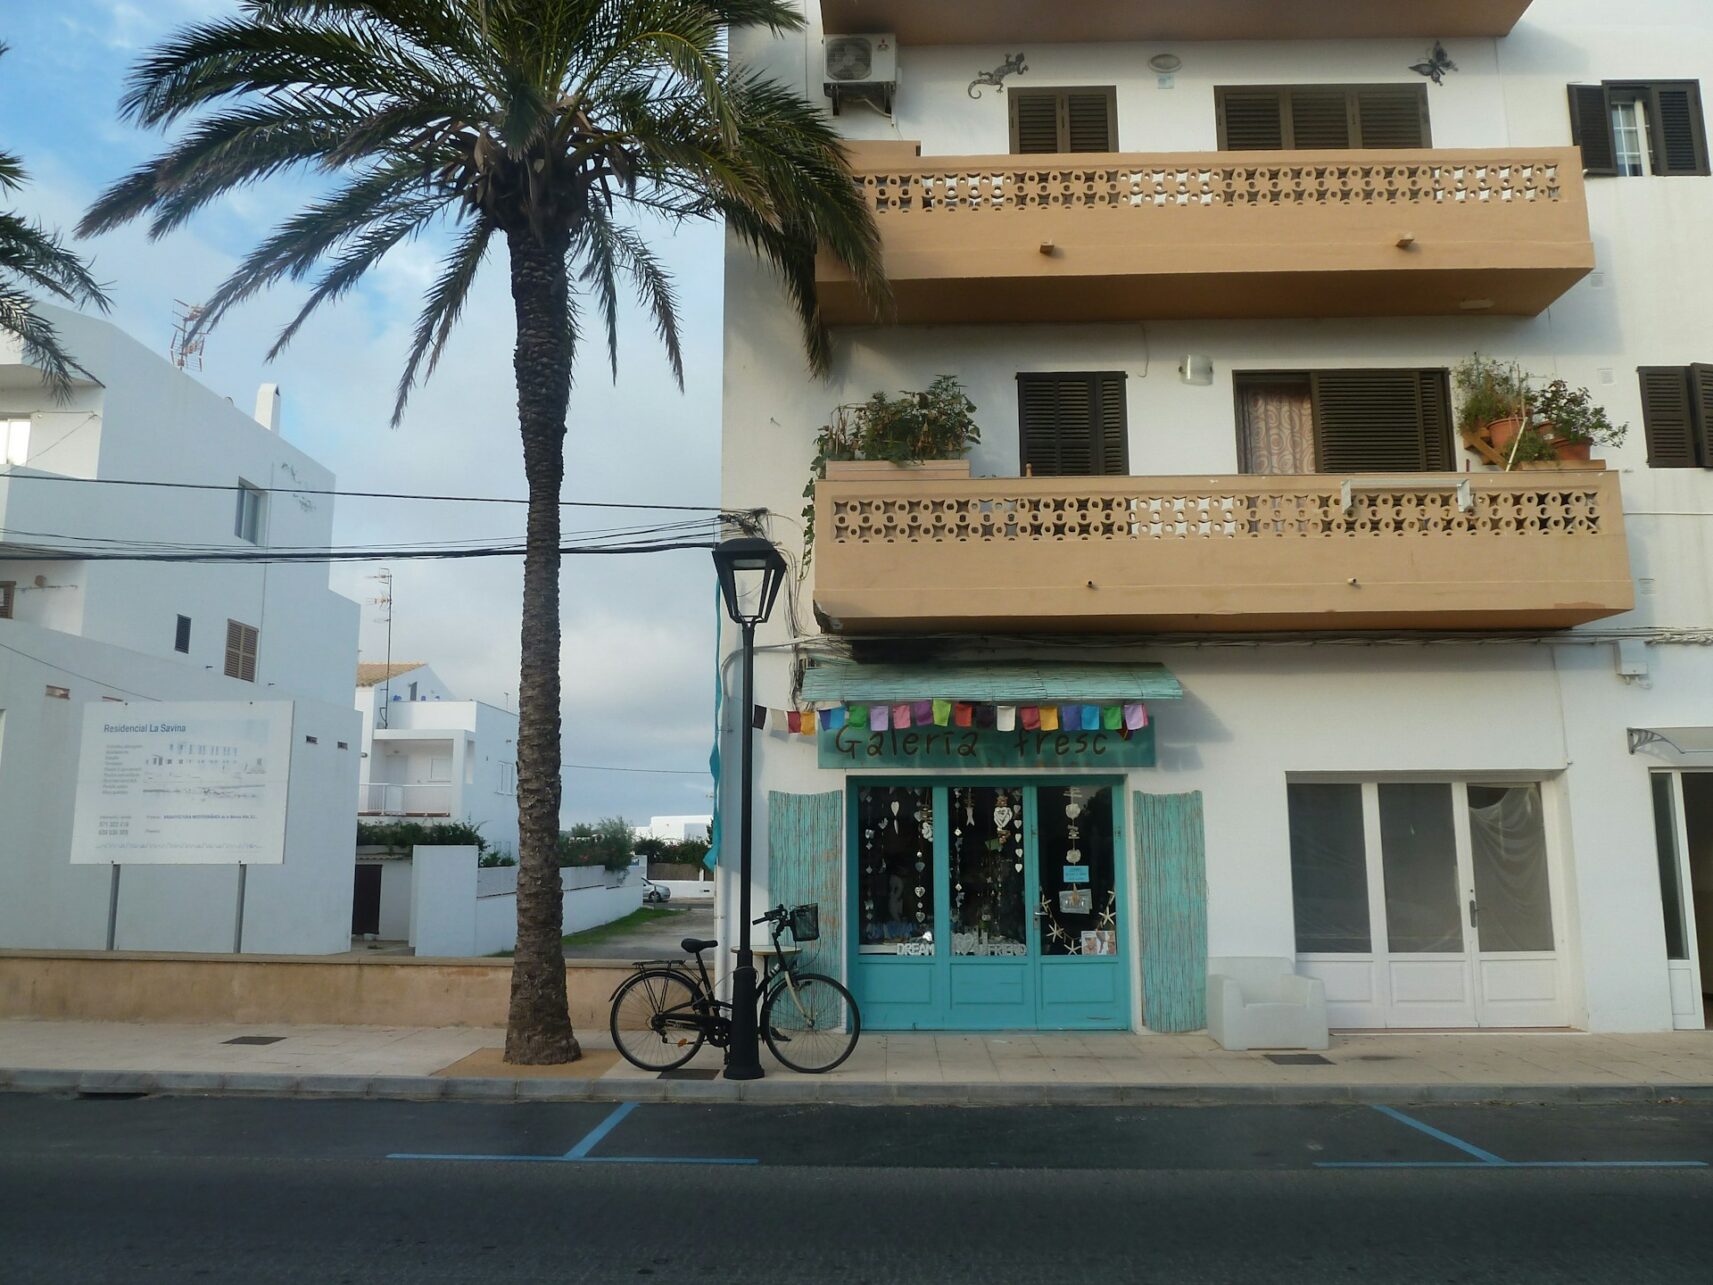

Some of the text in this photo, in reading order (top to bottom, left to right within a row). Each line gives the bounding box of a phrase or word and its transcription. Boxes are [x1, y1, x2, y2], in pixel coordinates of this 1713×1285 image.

[103, 723, 187, 733] Residencial La Savina
[896, 943, 935, 956] DREAM
[988, 943, 1027, 956] FRIEND
